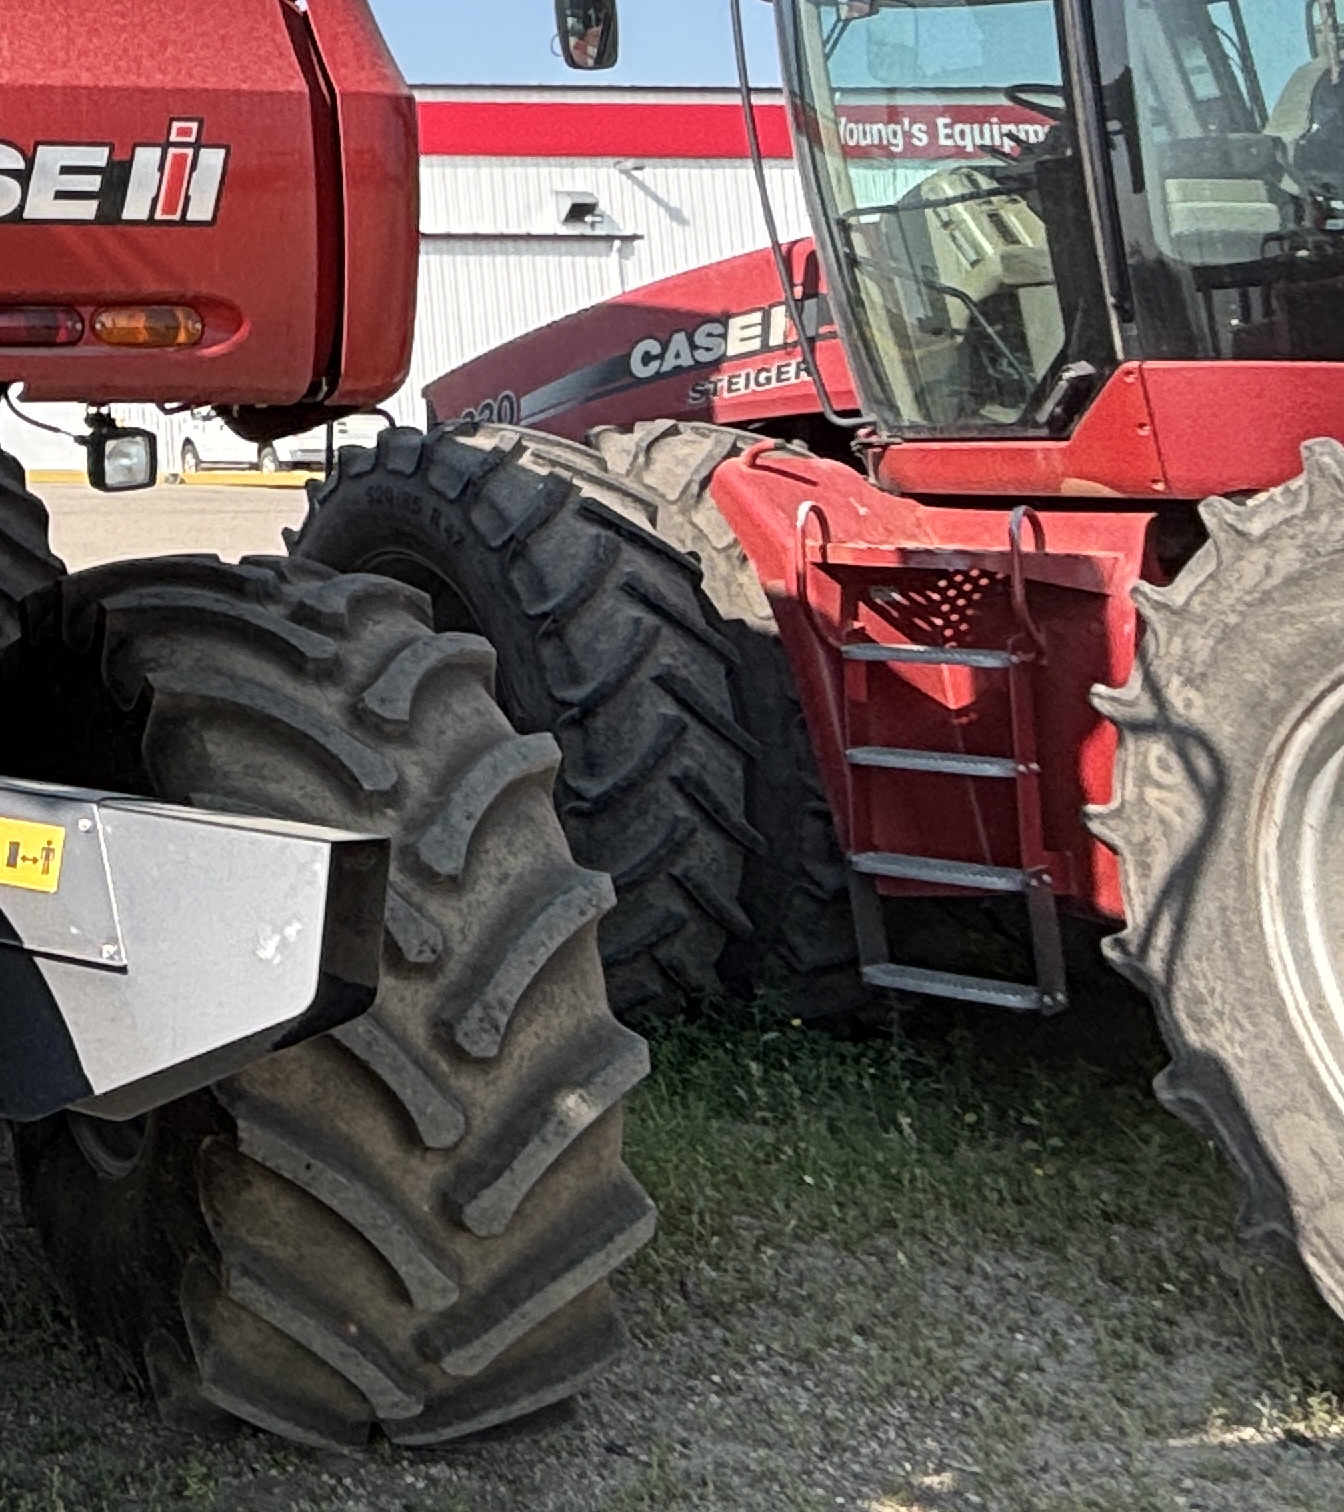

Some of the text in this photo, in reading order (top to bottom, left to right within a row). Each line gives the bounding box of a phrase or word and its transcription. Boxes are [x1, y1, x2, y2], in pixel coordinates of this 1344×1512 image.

[936, 117, 1050, 153] Equipm
[120, 119, 227, 223] IH
[629, 310, 764, 379] CASE
[687, 359, 814, 404] STEIGER
